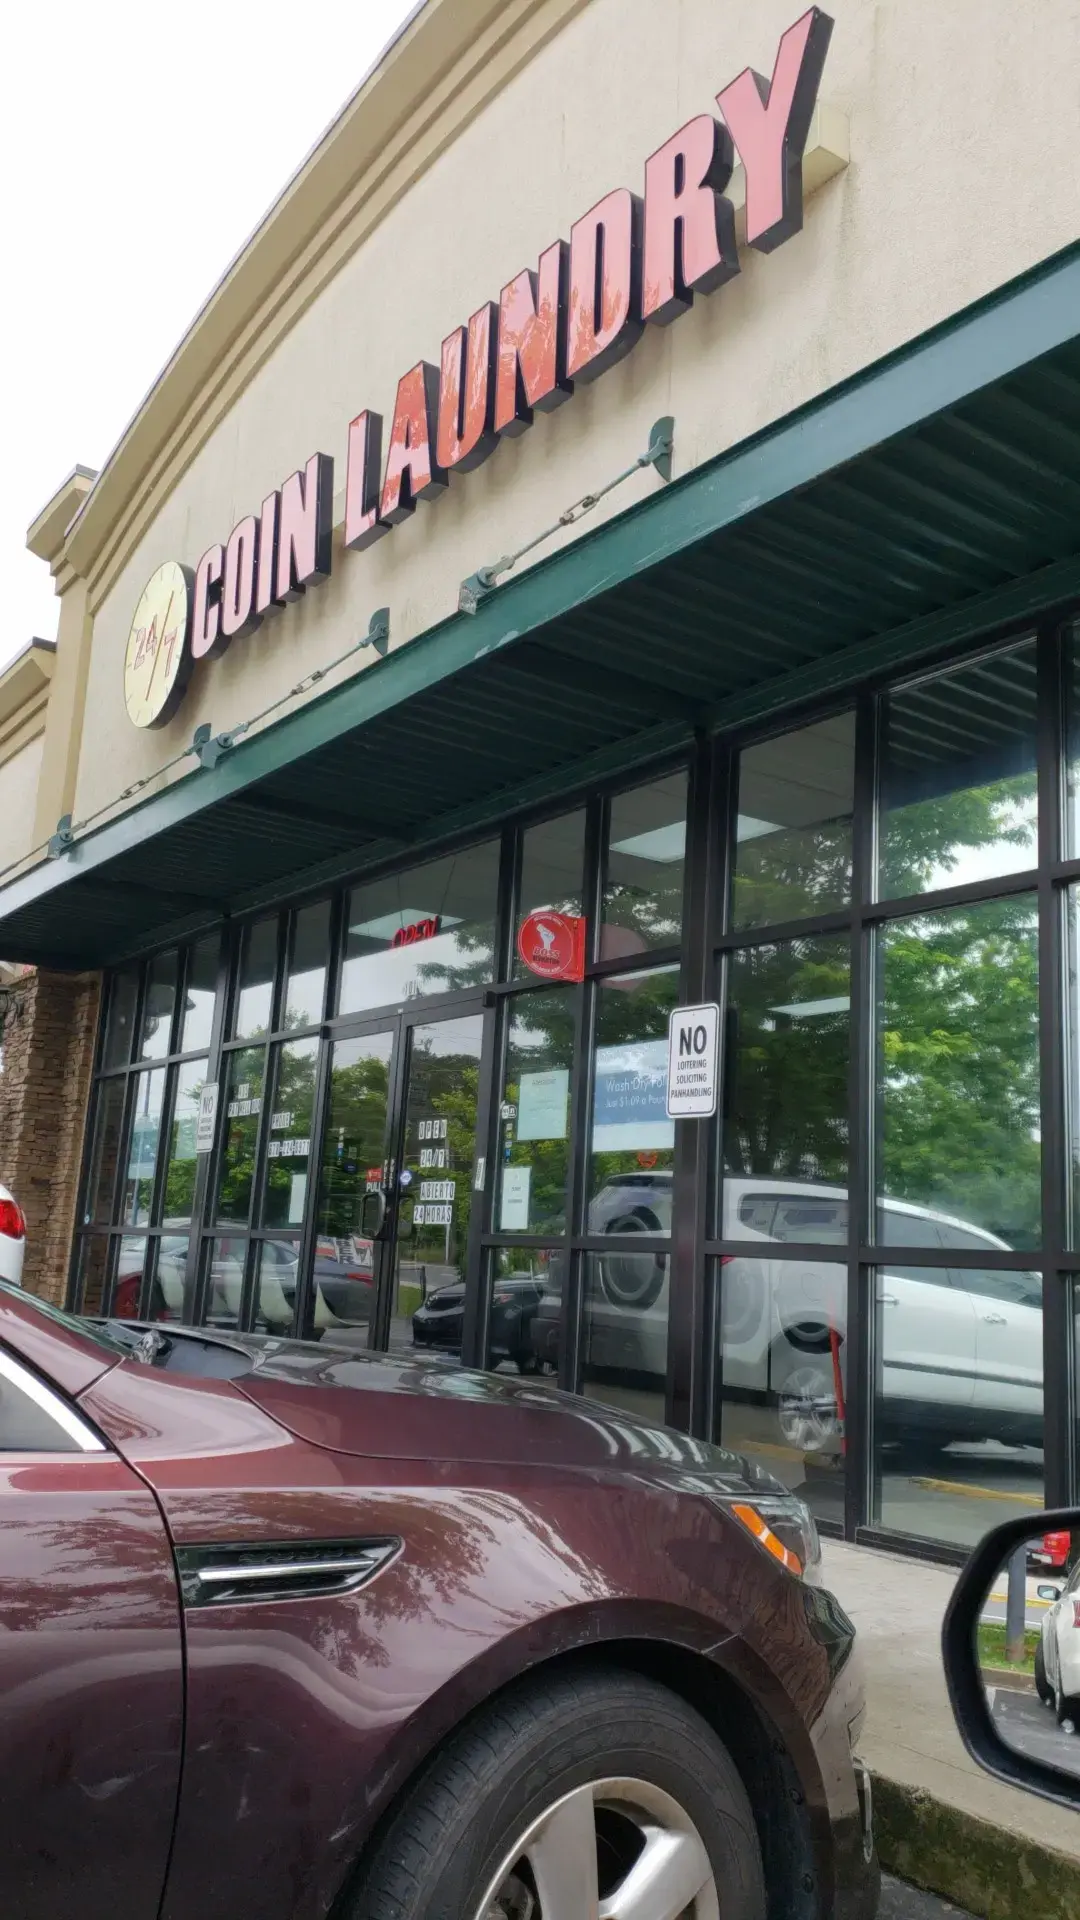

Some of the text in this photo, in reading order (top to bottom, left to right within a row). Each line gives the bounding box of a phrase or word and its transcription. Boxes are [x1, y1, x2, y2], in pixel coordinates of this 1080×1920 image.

[191, 5, 824, 659] COIN LAUNDRY
[391, 914, 440, 950] OPEN
[679, 1025, 707, 1056] NO
[677, 1059, 707, 1071] LOITERING
[606, 1078, 629, 1092] Wash
[676, 1073, 707, 1085] SOLICITING
[670, 1087, 712, 1099] PANHANDLING
[202, 1096, 214, 1114] NO
[419, 1120, 447, 1139] OPEN
[420, 1149, 445, 1168] 24/7
[421, 1182, 456, 1200] ABIERTO
[413, 1205, 452, 1224] 24 HORAS
